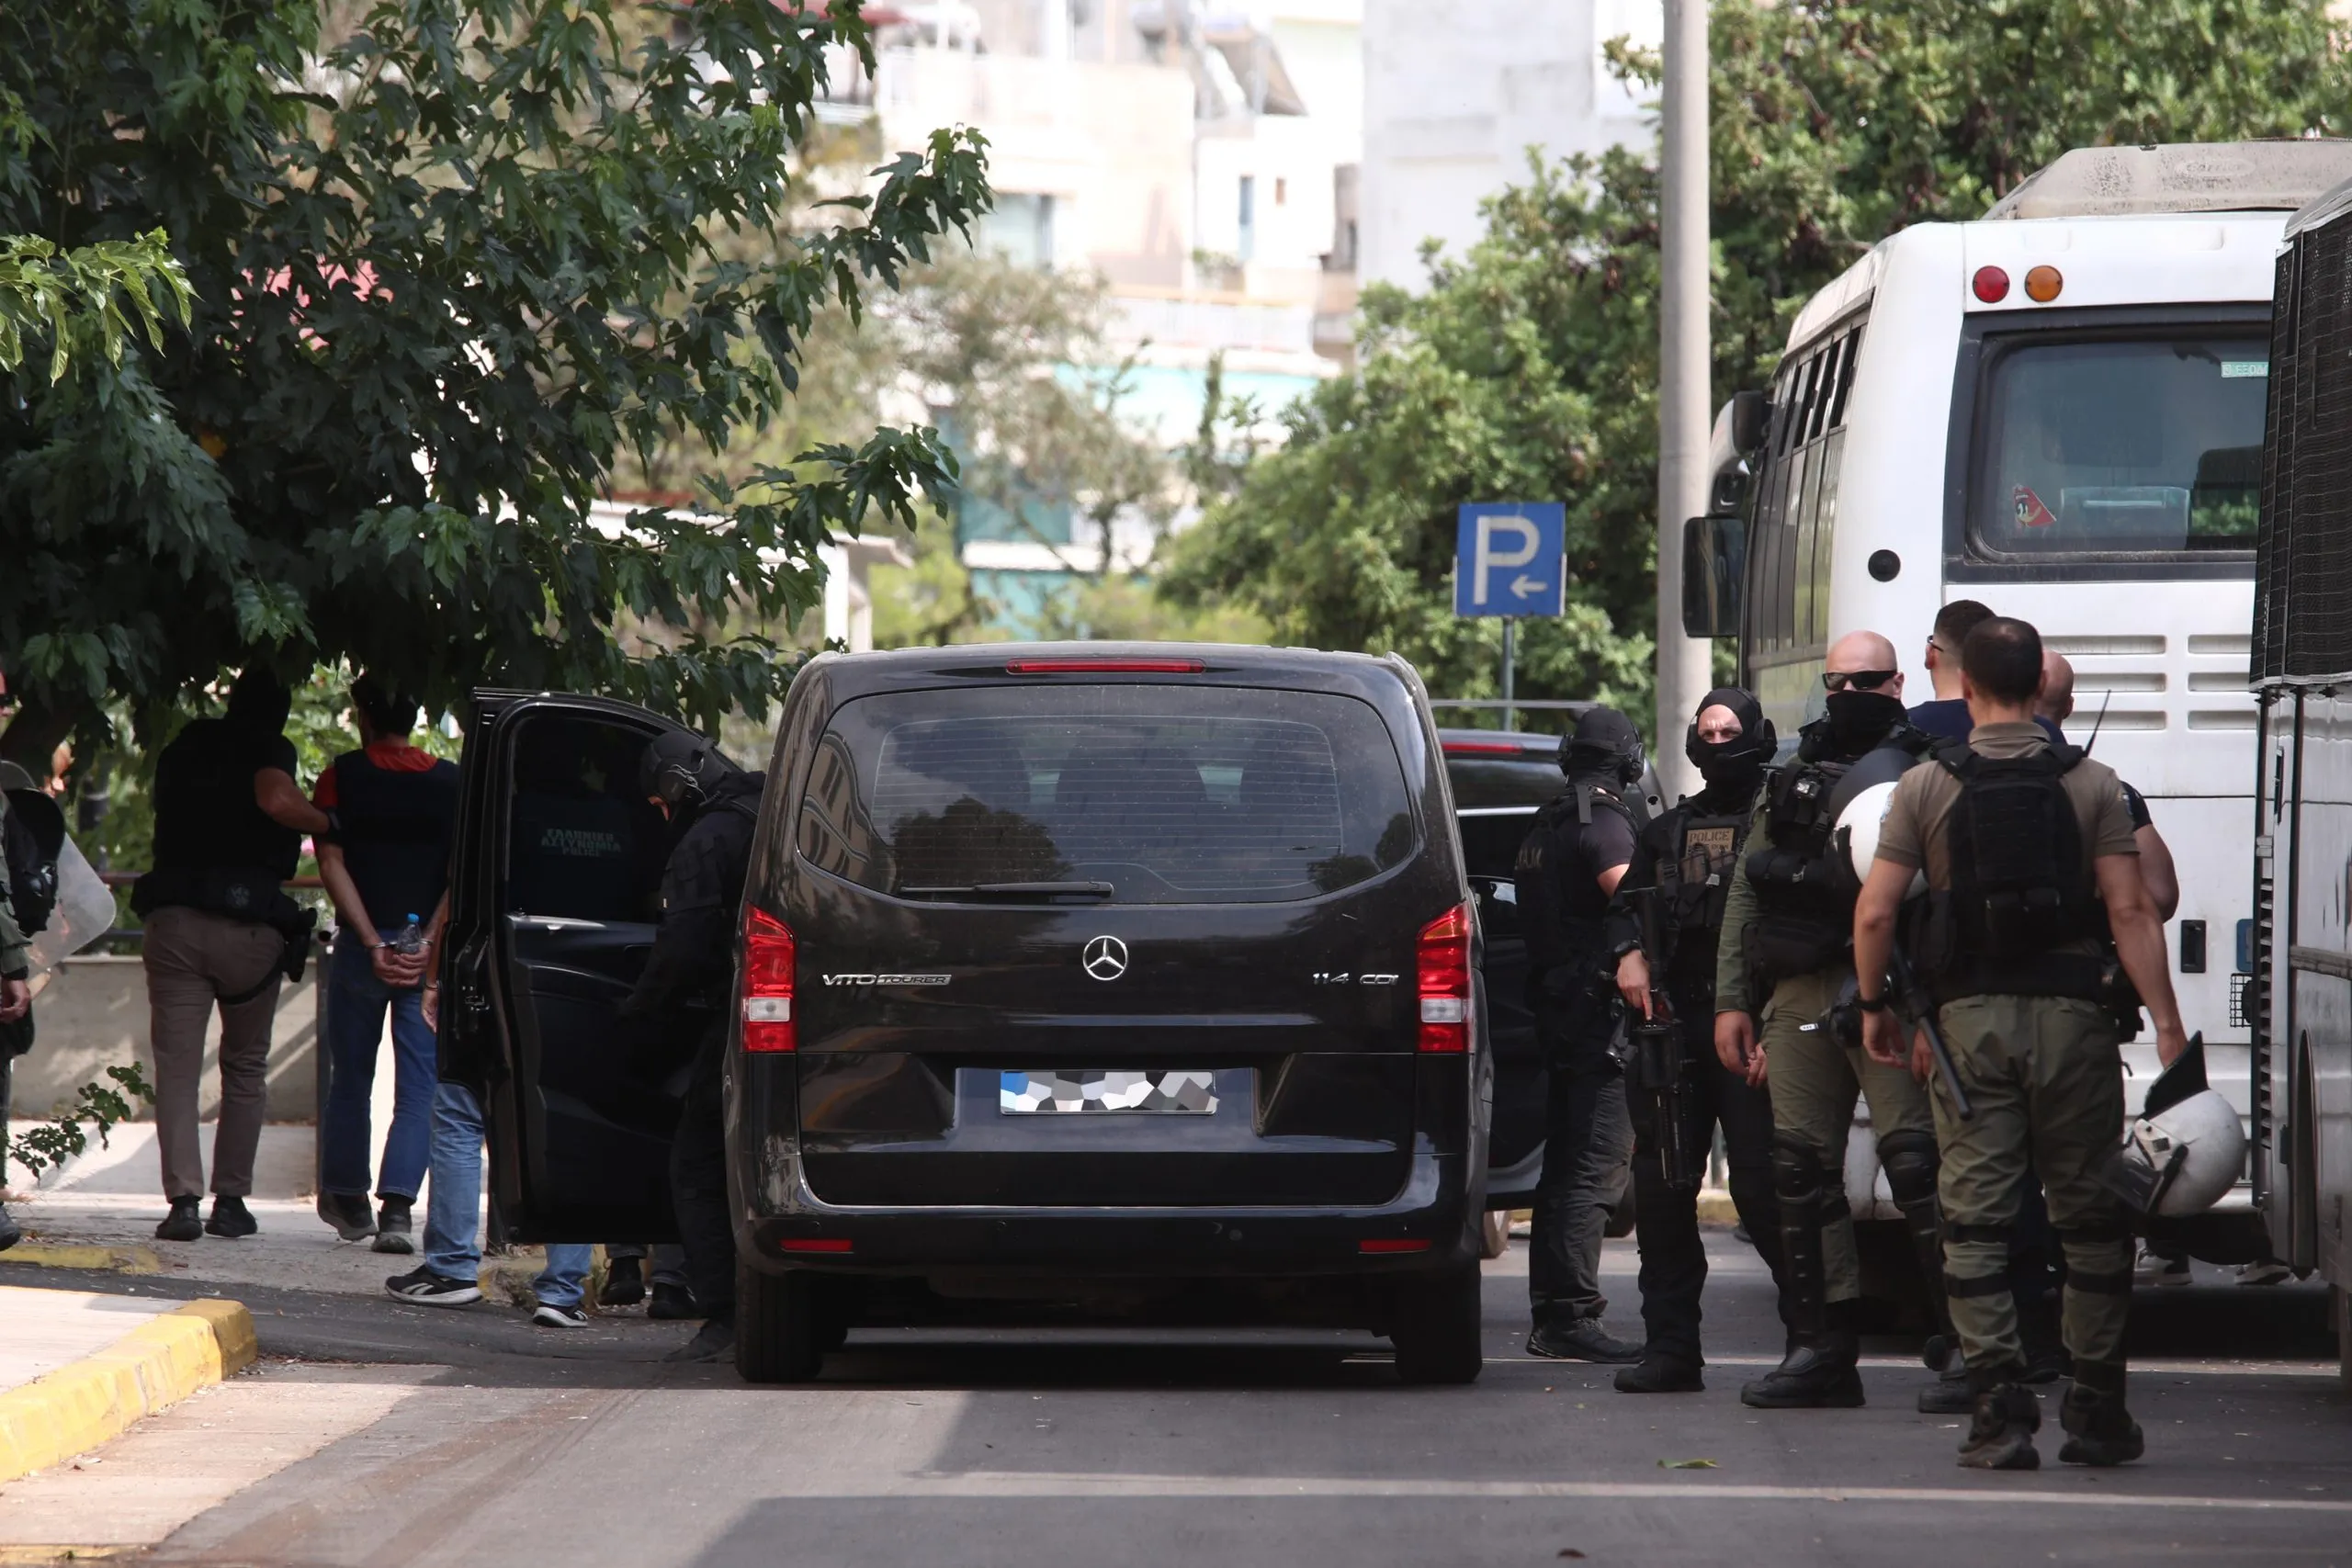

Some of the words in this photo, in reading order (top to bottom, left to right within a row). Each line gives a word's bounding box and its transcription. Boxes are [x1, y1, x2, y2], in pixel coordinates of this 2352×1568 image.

[1474, 515, 1540, 605] P
[1690, 830, 1730, 842] POLICE
[822, 974, 876, 986] VITO
[878, 975, 950, 986] TOURER
[1313, 972, 1350, 985] 114
[1360, 974, 1399, 986] CDI
